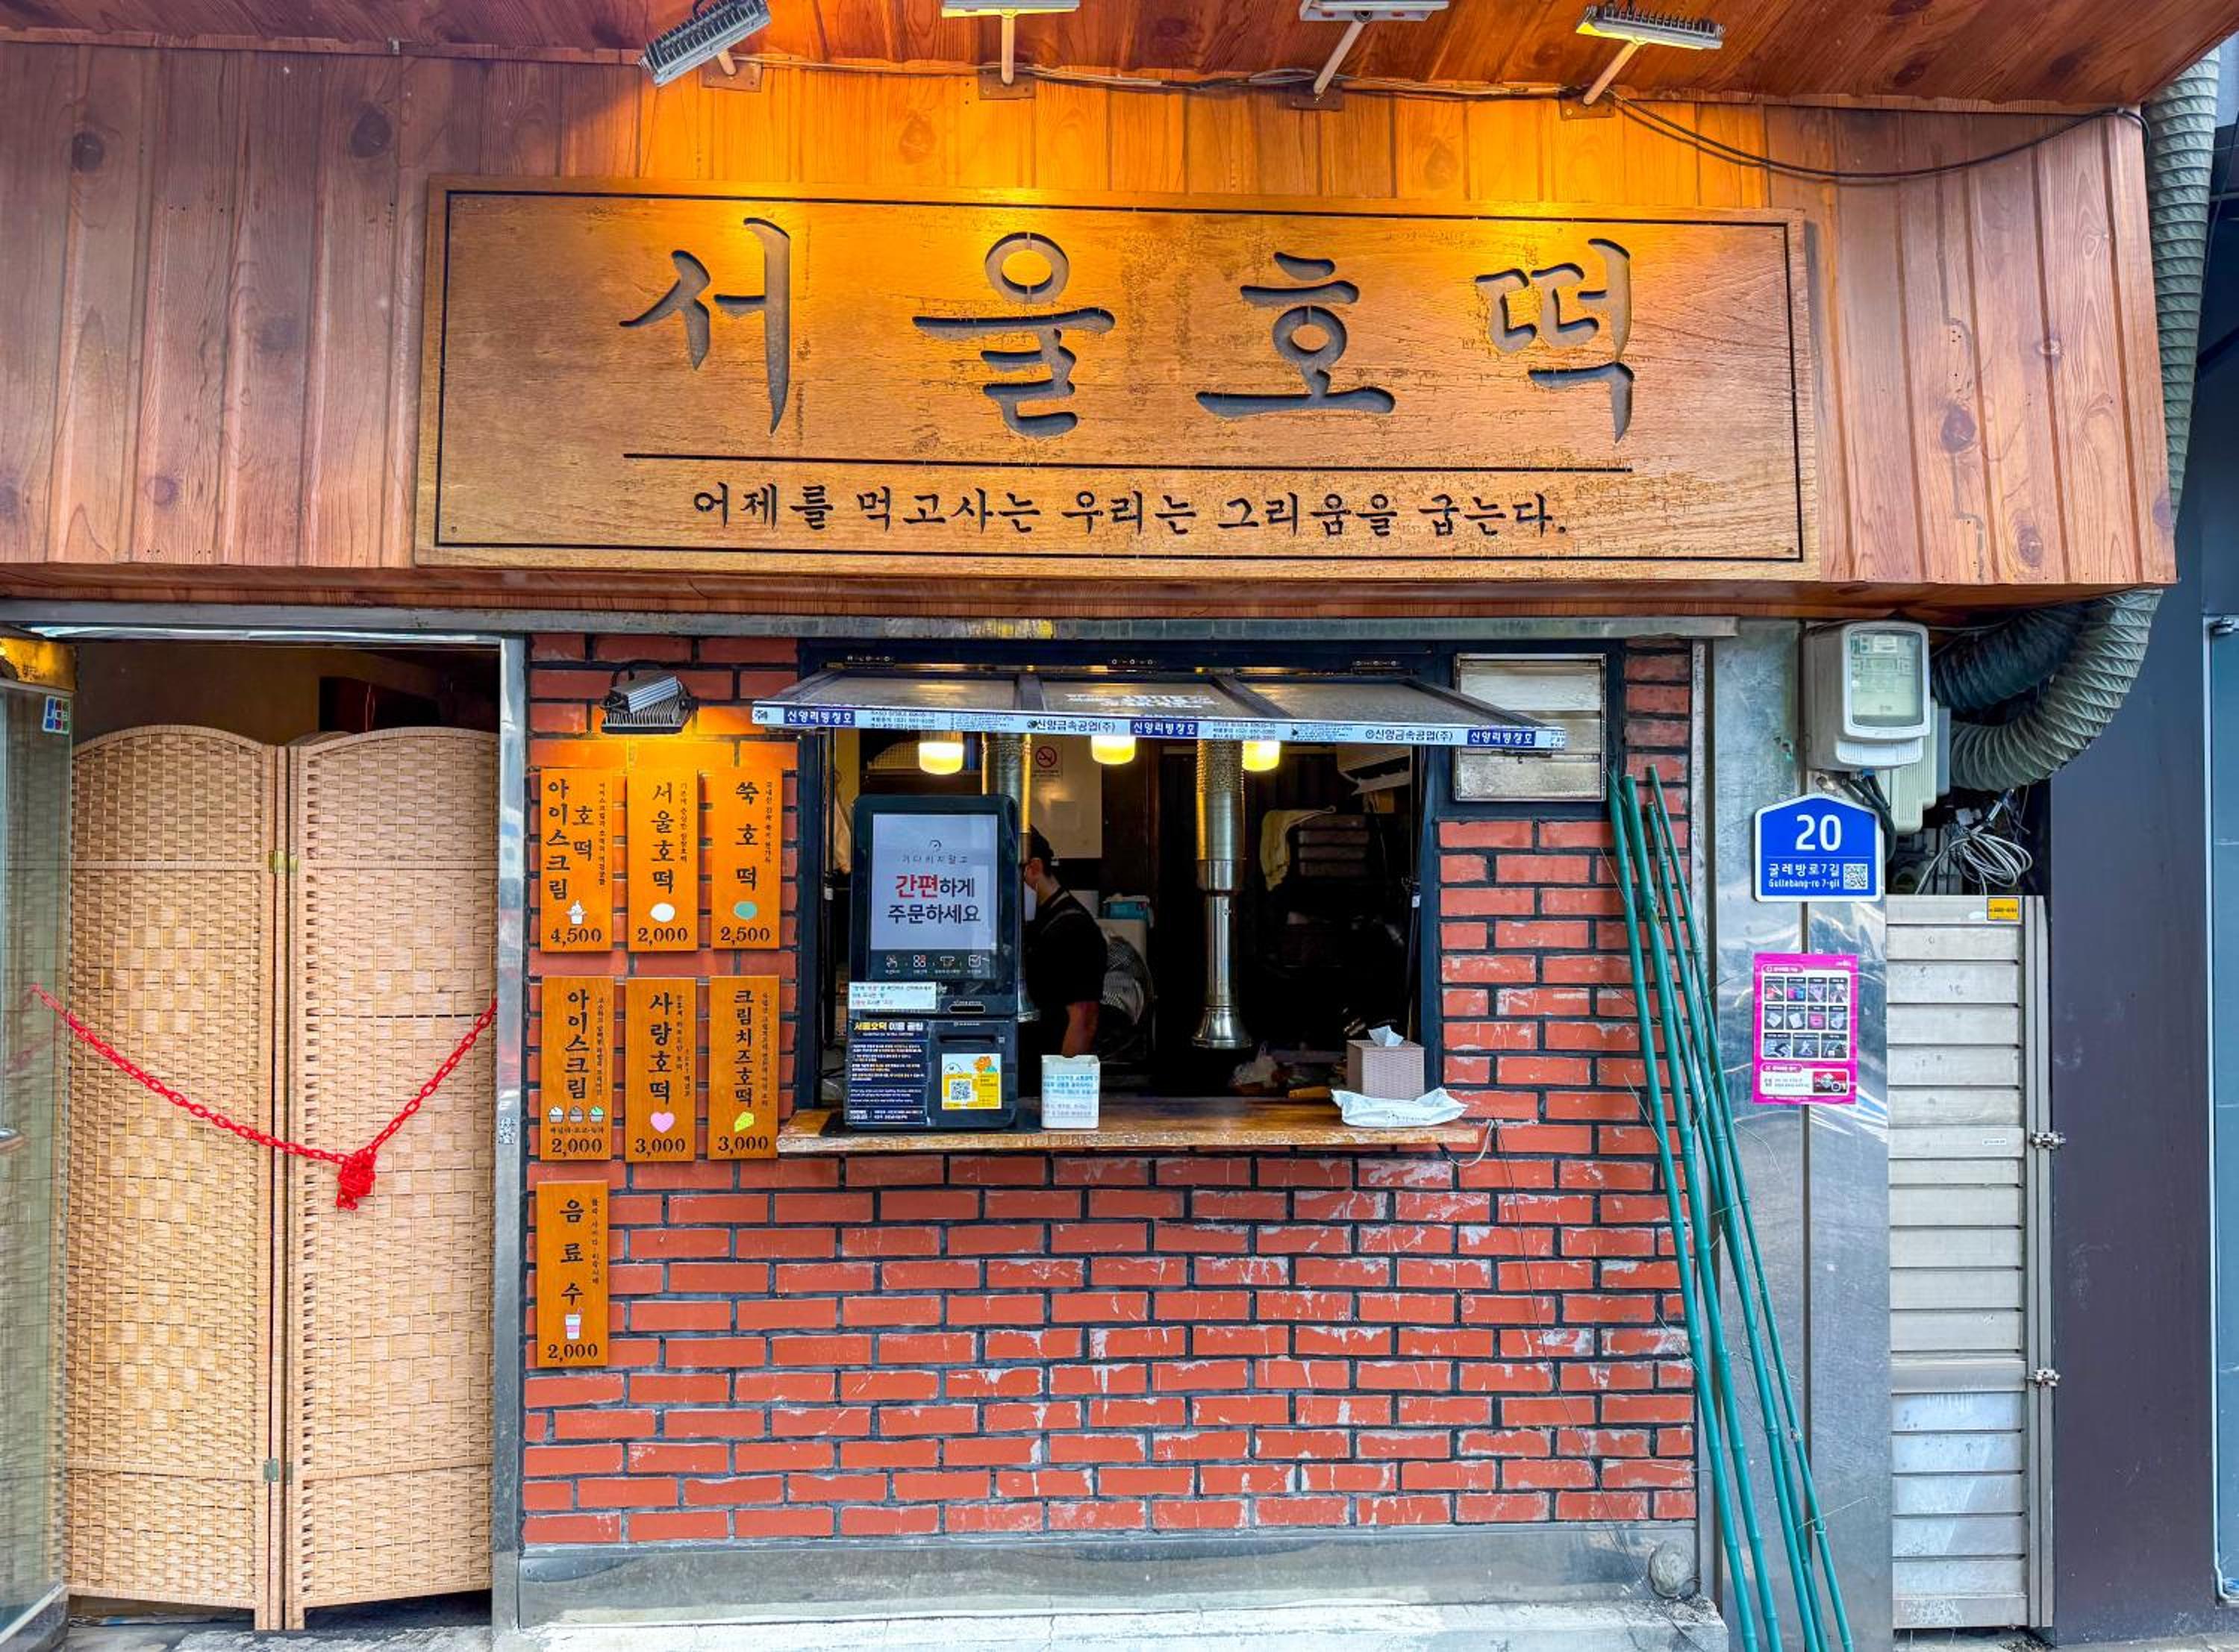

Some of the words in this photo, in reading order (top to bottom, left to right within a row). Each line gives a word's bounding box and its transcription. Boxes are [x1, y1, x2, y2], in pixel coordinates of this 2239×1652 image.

[619, 216, 1635, 443] 서울호떡
[693, 481, 834, 531] 어제를
[856, 486, 1041, 535] 먹고사는
[1061, 489, 1197, 535] 우리는
[1218, 491, 1399, 537] 그리움을
[1417, 492, 1567, 539] 굽는다.
[1035, 718, 1116, 733] 신양금속공업(주)
[1373, 729, 1454, 742] 신양금속공업(주)
[546, 777, 571, 901] 아이스크림
[572, 805, 594, 863] 호떡
[650, 781, 675, 895] 서울호떡
[1795, 813, 1842, 852] 20
[895, 874, 975, 899] 간편하게
[887, 904, 981, 925] 주문하세요
[550, 927, 602, 947] 4,500
[637, 927, 689, 947] 2,000
[720, 926, 770, 946] 2,500
[563, 988, 590, 1101] 아이스크림
[648, 992, 674, 1106] 사랑호떡
[733, 989, 755, 1108] 크림치즈호떡
[551, 1137, 602, 1158] 2,000
[635, 1138, 686, 1158] 3,000
[717, 1136, 769, 1156] 3,000
[559, 1198, 585, 1307] 음료수
[547, 1343, 599, 1362] 2,000
